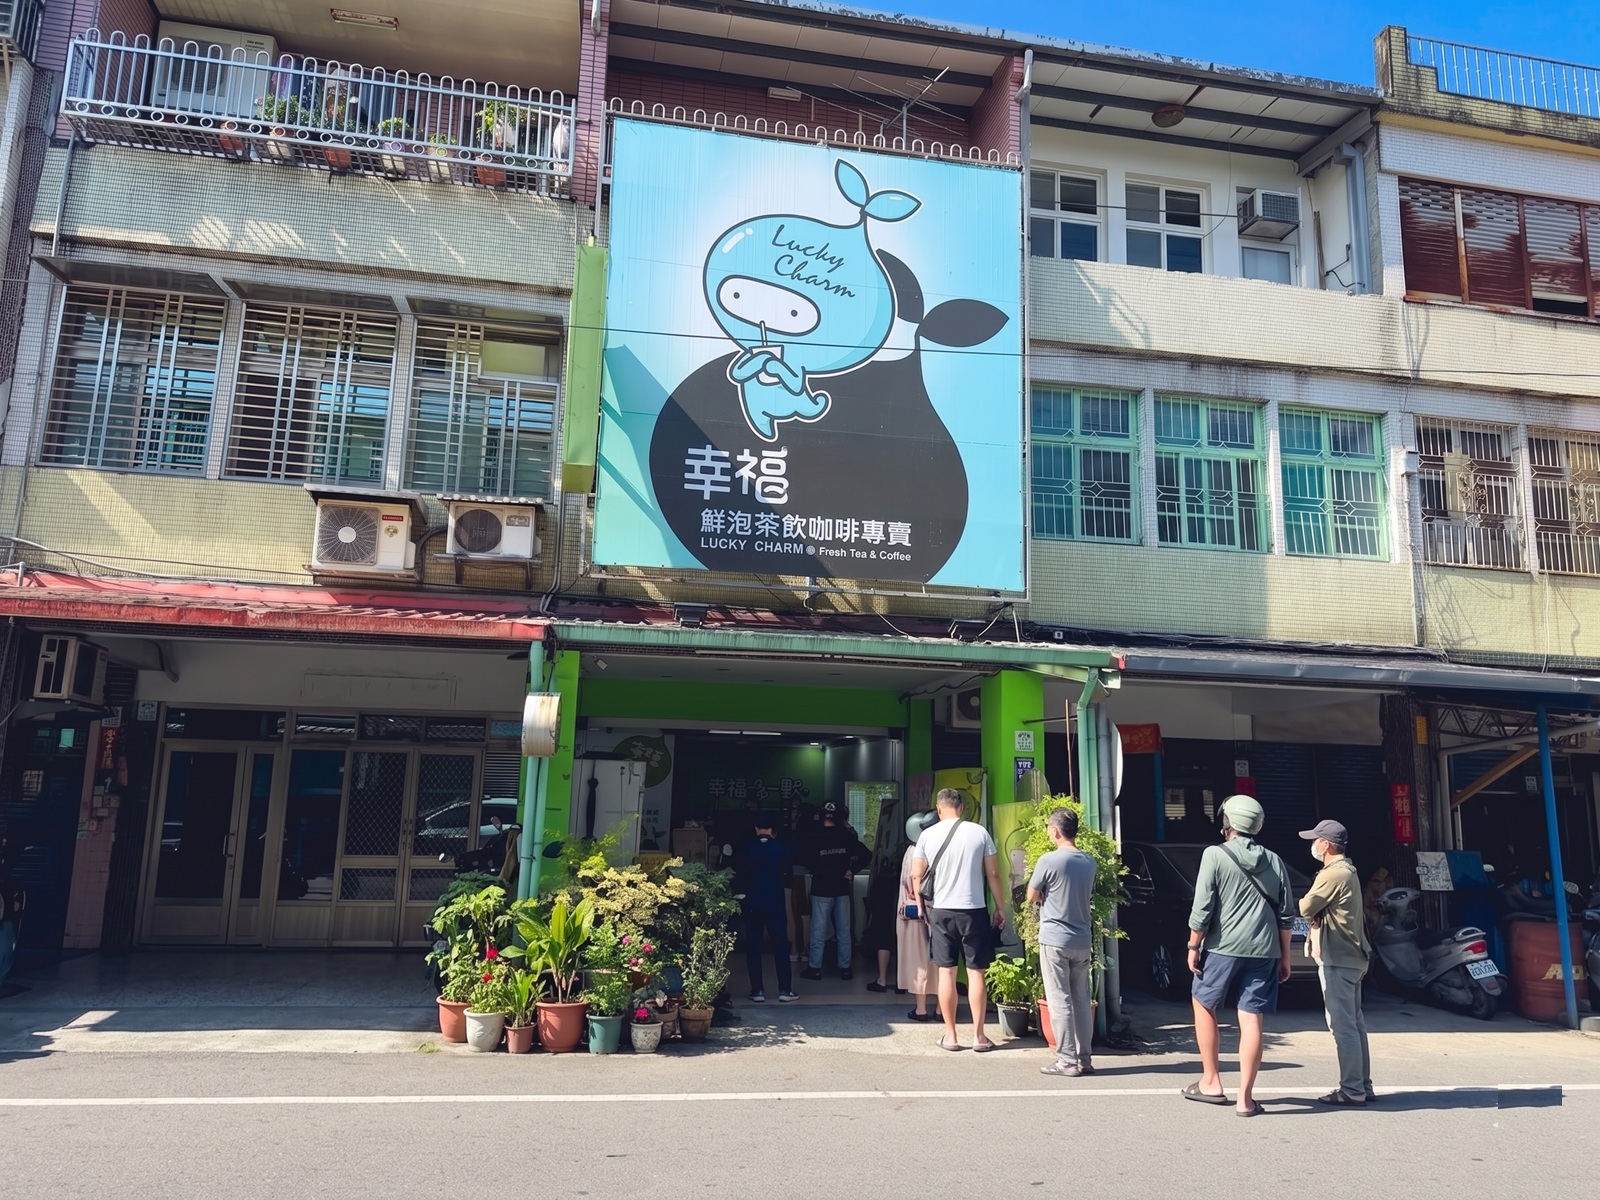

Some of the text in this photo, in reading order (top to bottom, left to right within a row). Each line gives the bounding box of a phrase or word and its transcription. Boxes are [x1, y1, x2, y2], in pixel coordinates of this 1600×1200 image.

[772, 224, 845, 273] Lucky
[774, 254, 855, 298] Charm
[683, 444, 790, 505] 幸福
[700, 507, 912, 547] 鮮泡茶飲咖啡專賣
[701, 537, 912, 562] LUCKY CHARM Fresh Tea & Coffee
